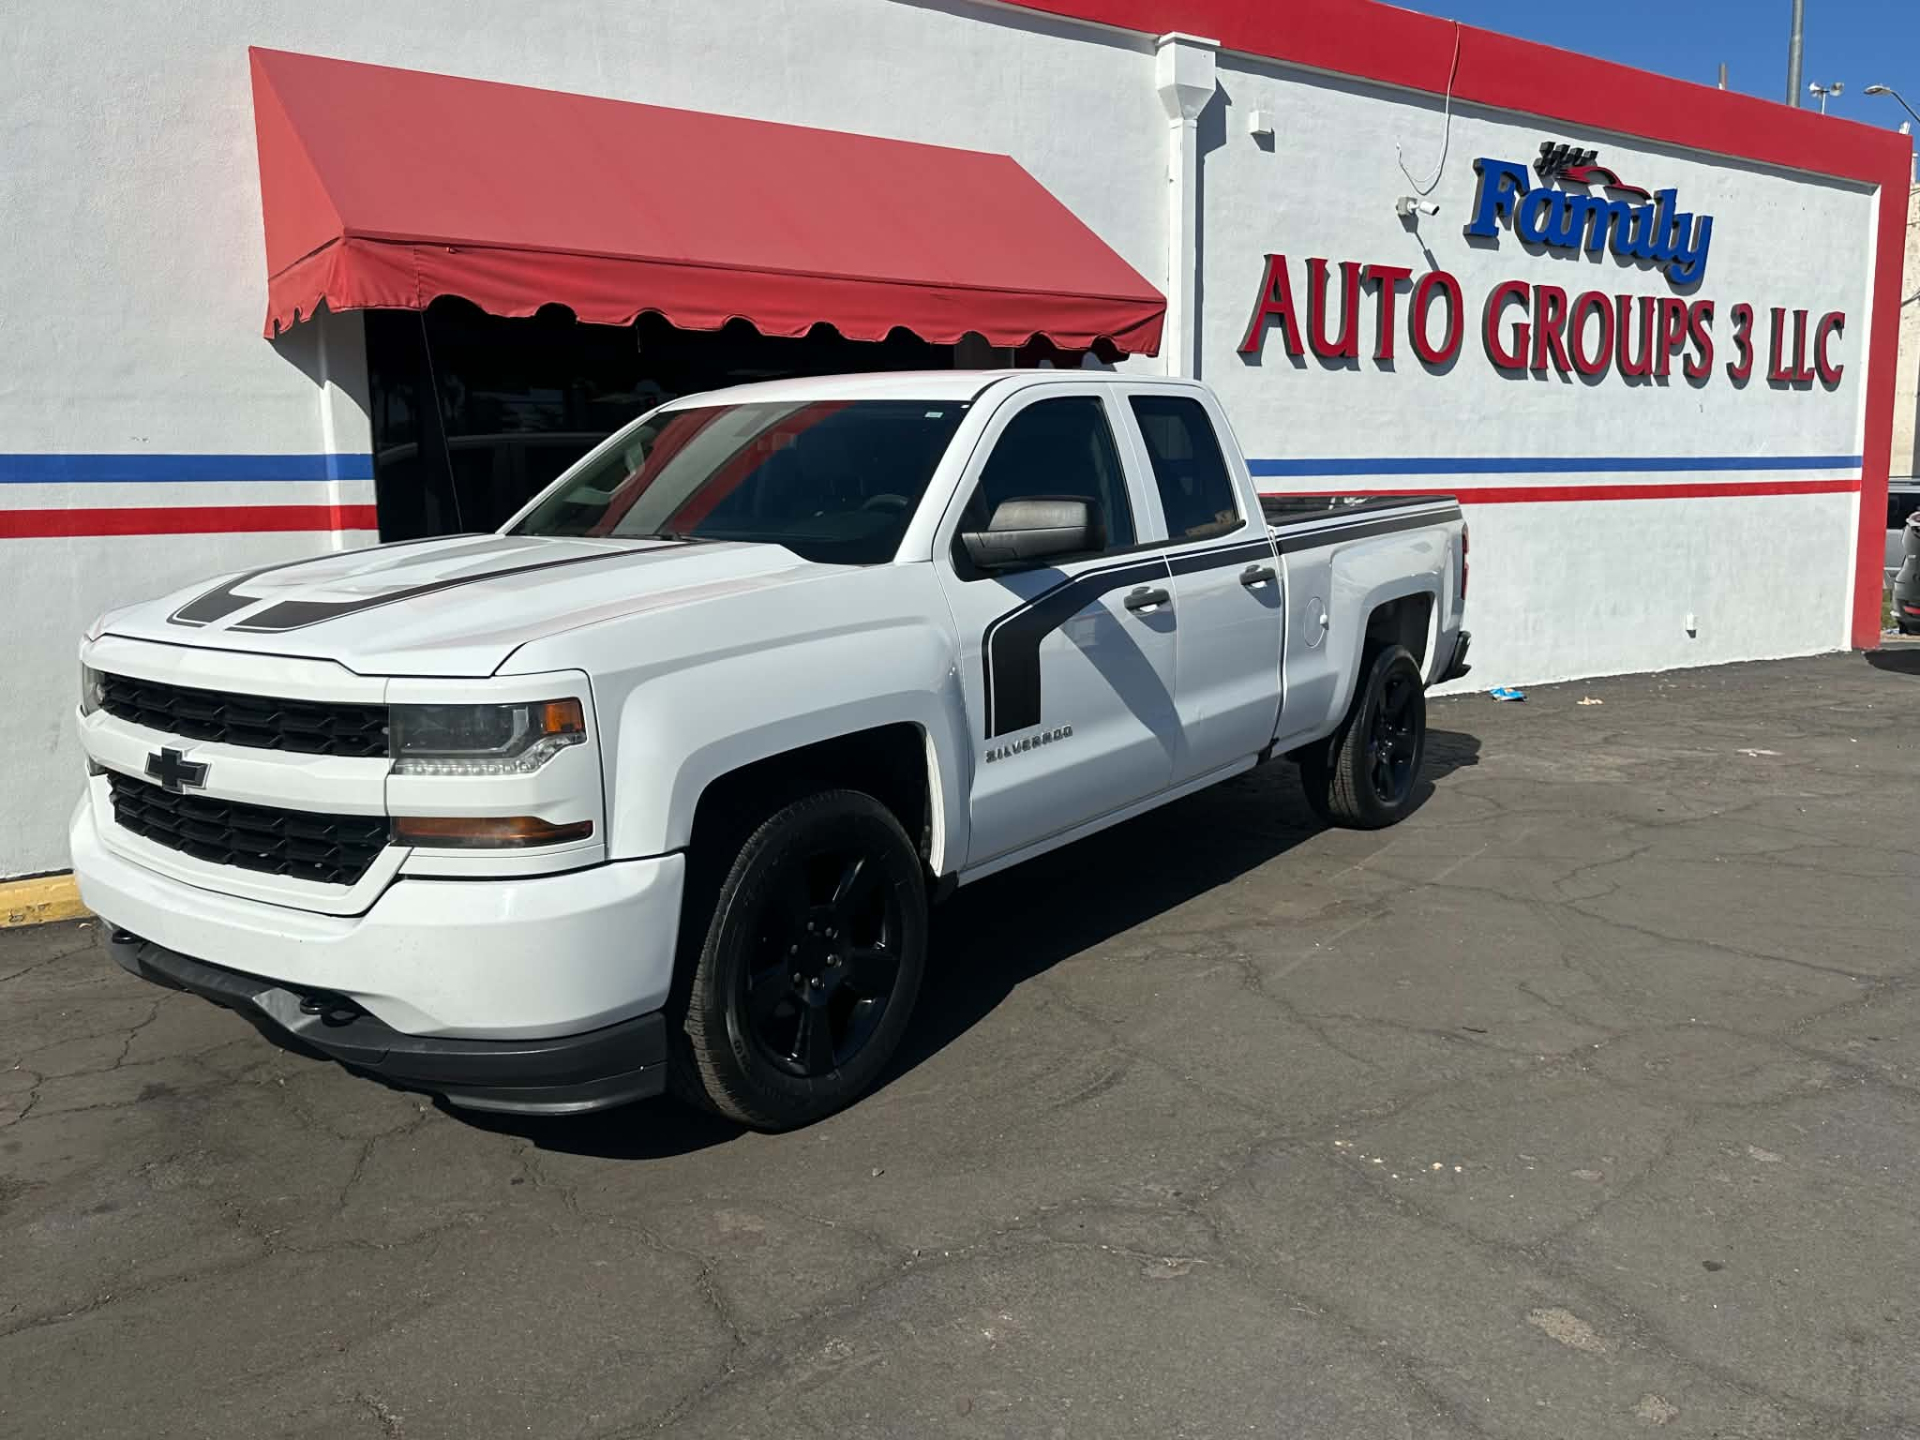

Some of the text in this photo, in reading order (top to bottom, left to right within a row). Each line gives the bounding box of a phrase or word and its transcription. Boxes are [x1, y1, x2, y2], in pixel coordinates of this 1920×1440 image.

[1464, 157, 1713, 285] Family
[1237, 254, 1845, 383] AUTO GROUPS 3 LLC
[985, 725, 1073, 763] SILVERADO
